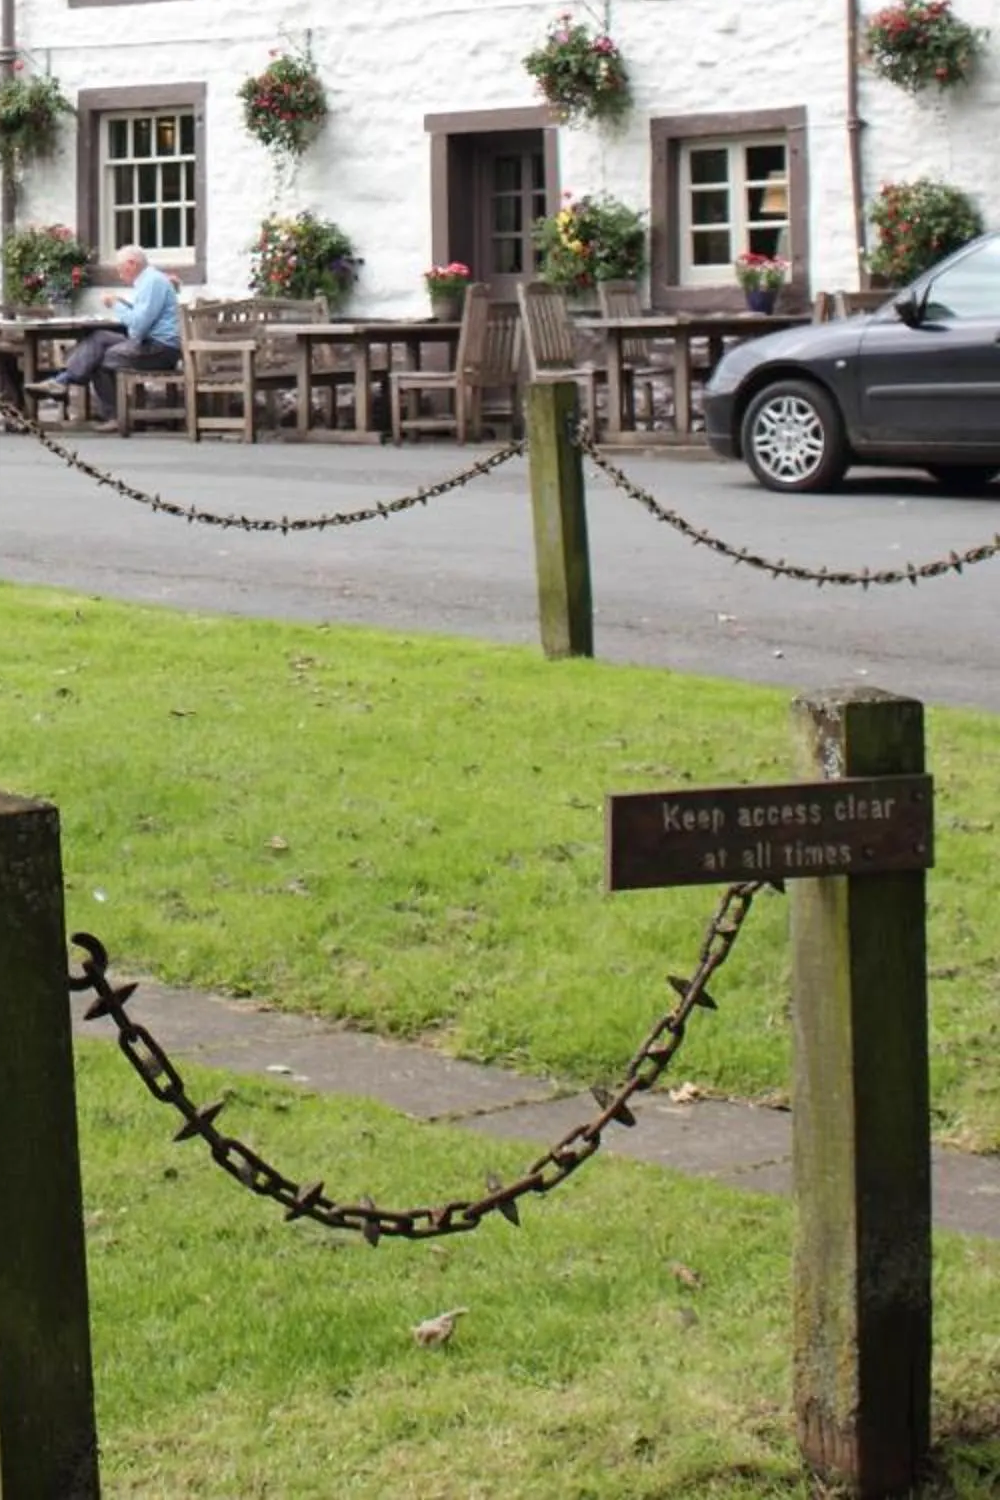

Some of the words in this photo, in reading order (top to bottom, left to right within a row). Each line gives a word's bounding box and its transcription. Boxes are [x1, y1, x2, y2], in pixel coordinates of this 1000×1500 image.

[663, 801, 724, 832] Keep
[737, 801, 821, 826] access
[835, 794, 896, 820] clear
[703, 849, 726, 869] at
[742, 841, 772, 867] all
[784, 843, 851, 867] times
